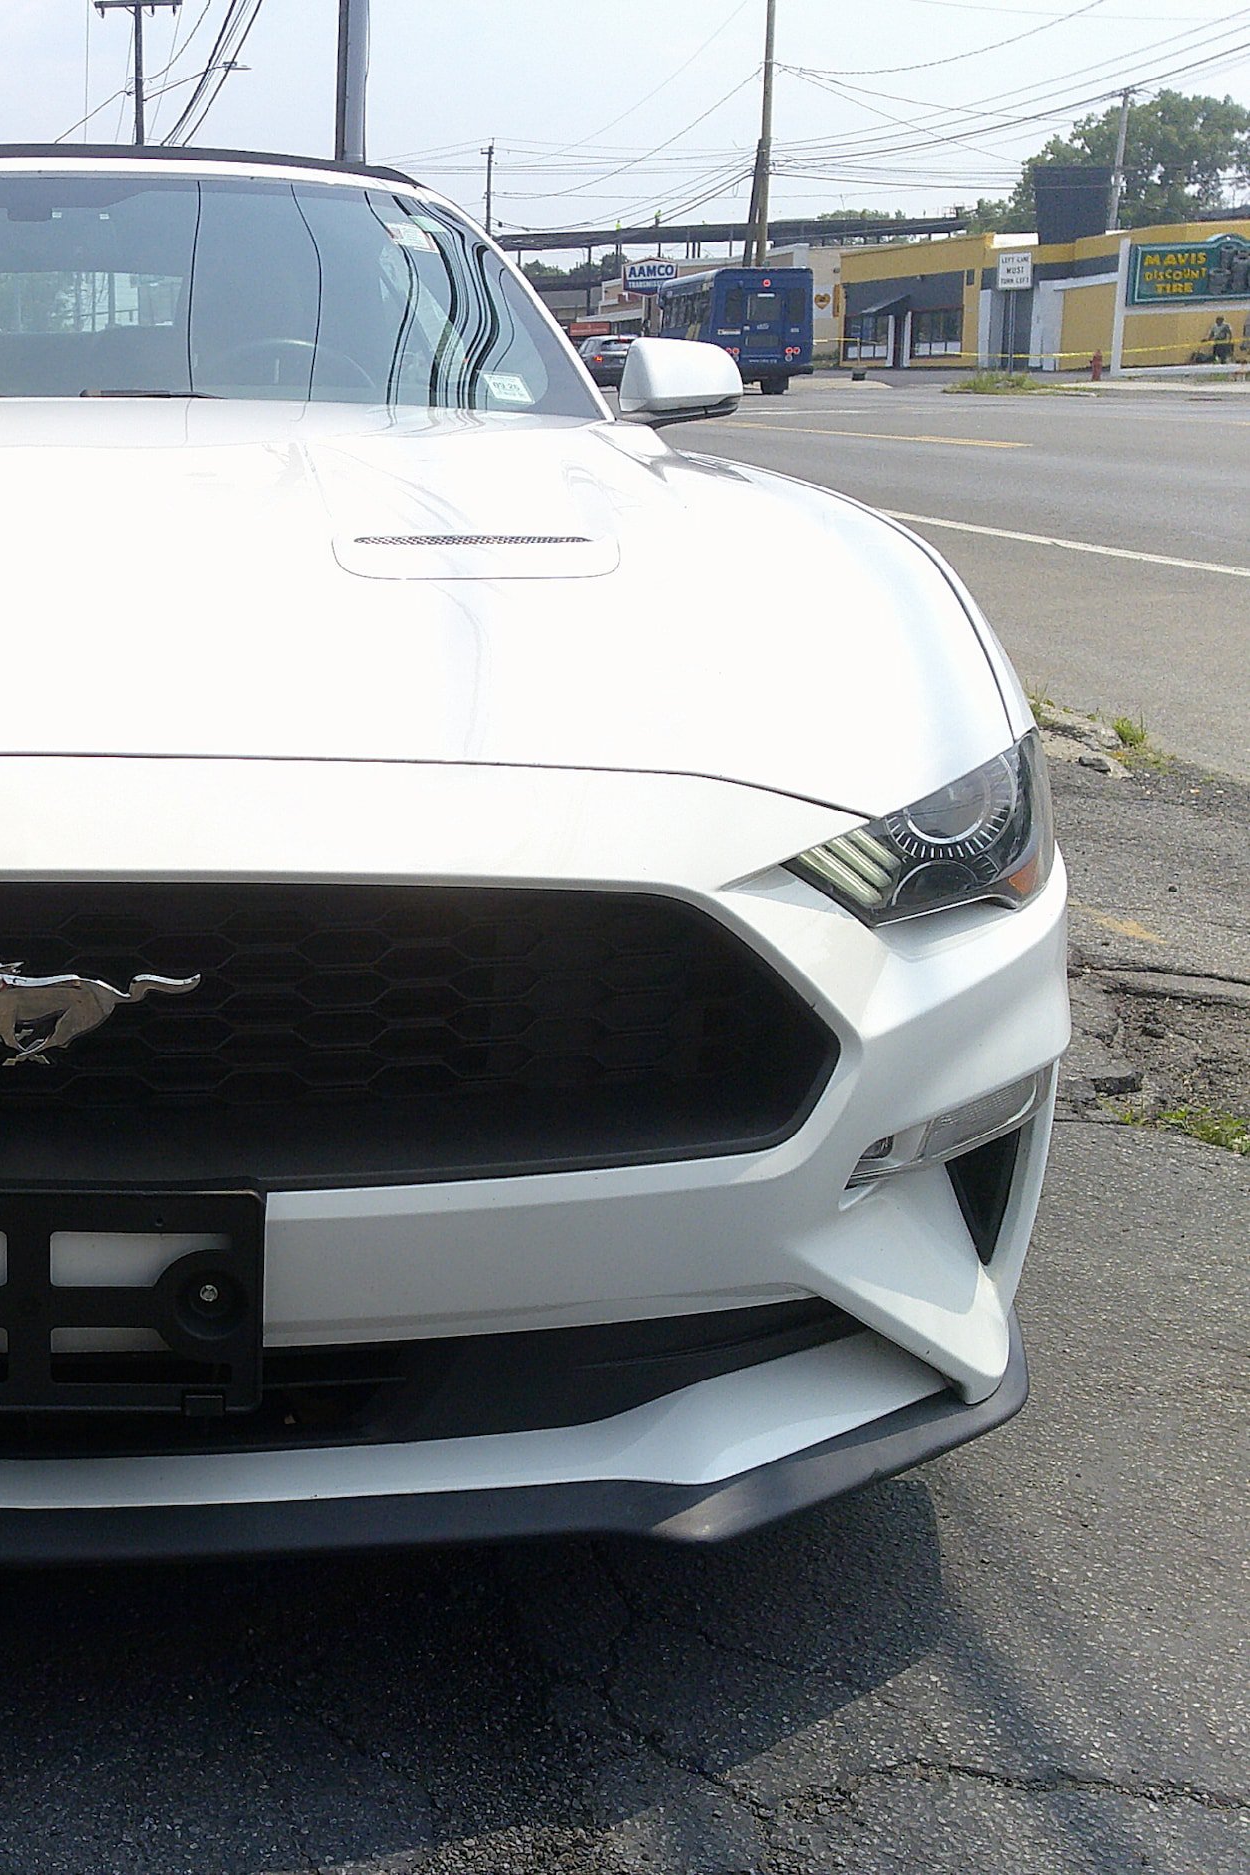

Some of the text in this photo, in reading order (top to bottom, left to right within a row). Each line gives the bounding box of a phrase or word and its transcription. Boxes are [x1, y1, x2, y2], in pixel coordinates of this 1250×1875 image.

[1144, 252, 1207, 267] MAVIS
[629, 265, 674, 278] AAMCO
[1006, 266, 1024, 274] MUST
[1144, 267, 1208, 281] DISCOUNT
[1156, 283, 1193, 294] TIRE
